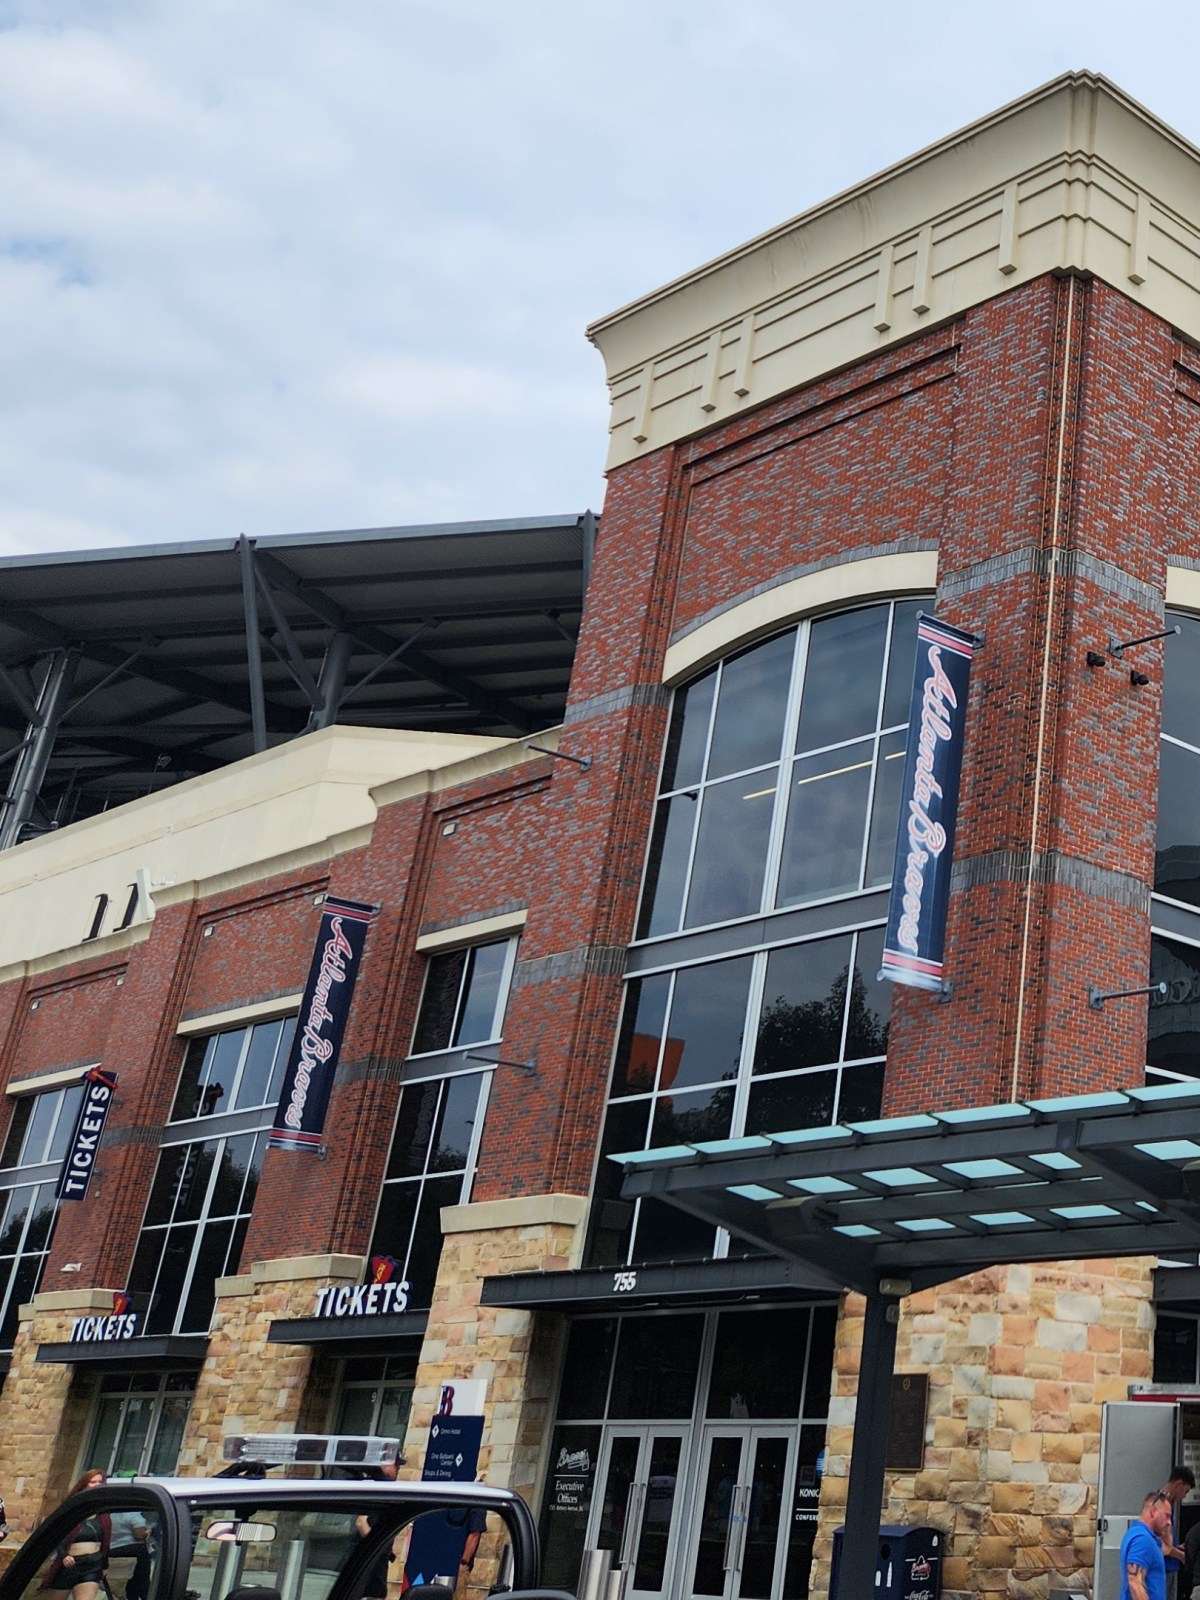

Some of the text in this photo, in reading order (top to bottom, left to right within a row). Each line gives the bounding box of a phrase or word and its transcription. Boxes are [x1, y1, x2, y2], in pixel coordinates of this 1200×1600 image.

[898, 645, 957, 956] Atlanta Braves
[284, 916, 353, 1129] Atlanta Braves
[65, 1086, 110, 1193] TICKETS
[613, 1271, 637, 1291] 755
[315, 1281, 410, 1317] TICKETS
[69, 1313, 138, 1343] TICKETS
[555, 1480, 585, 1491] Executive
[799, 1488, 820, 1498] KONIC
[557, 1493, 579, 1504] Offices
[795, 1513, 819, 1521] CONFERE
